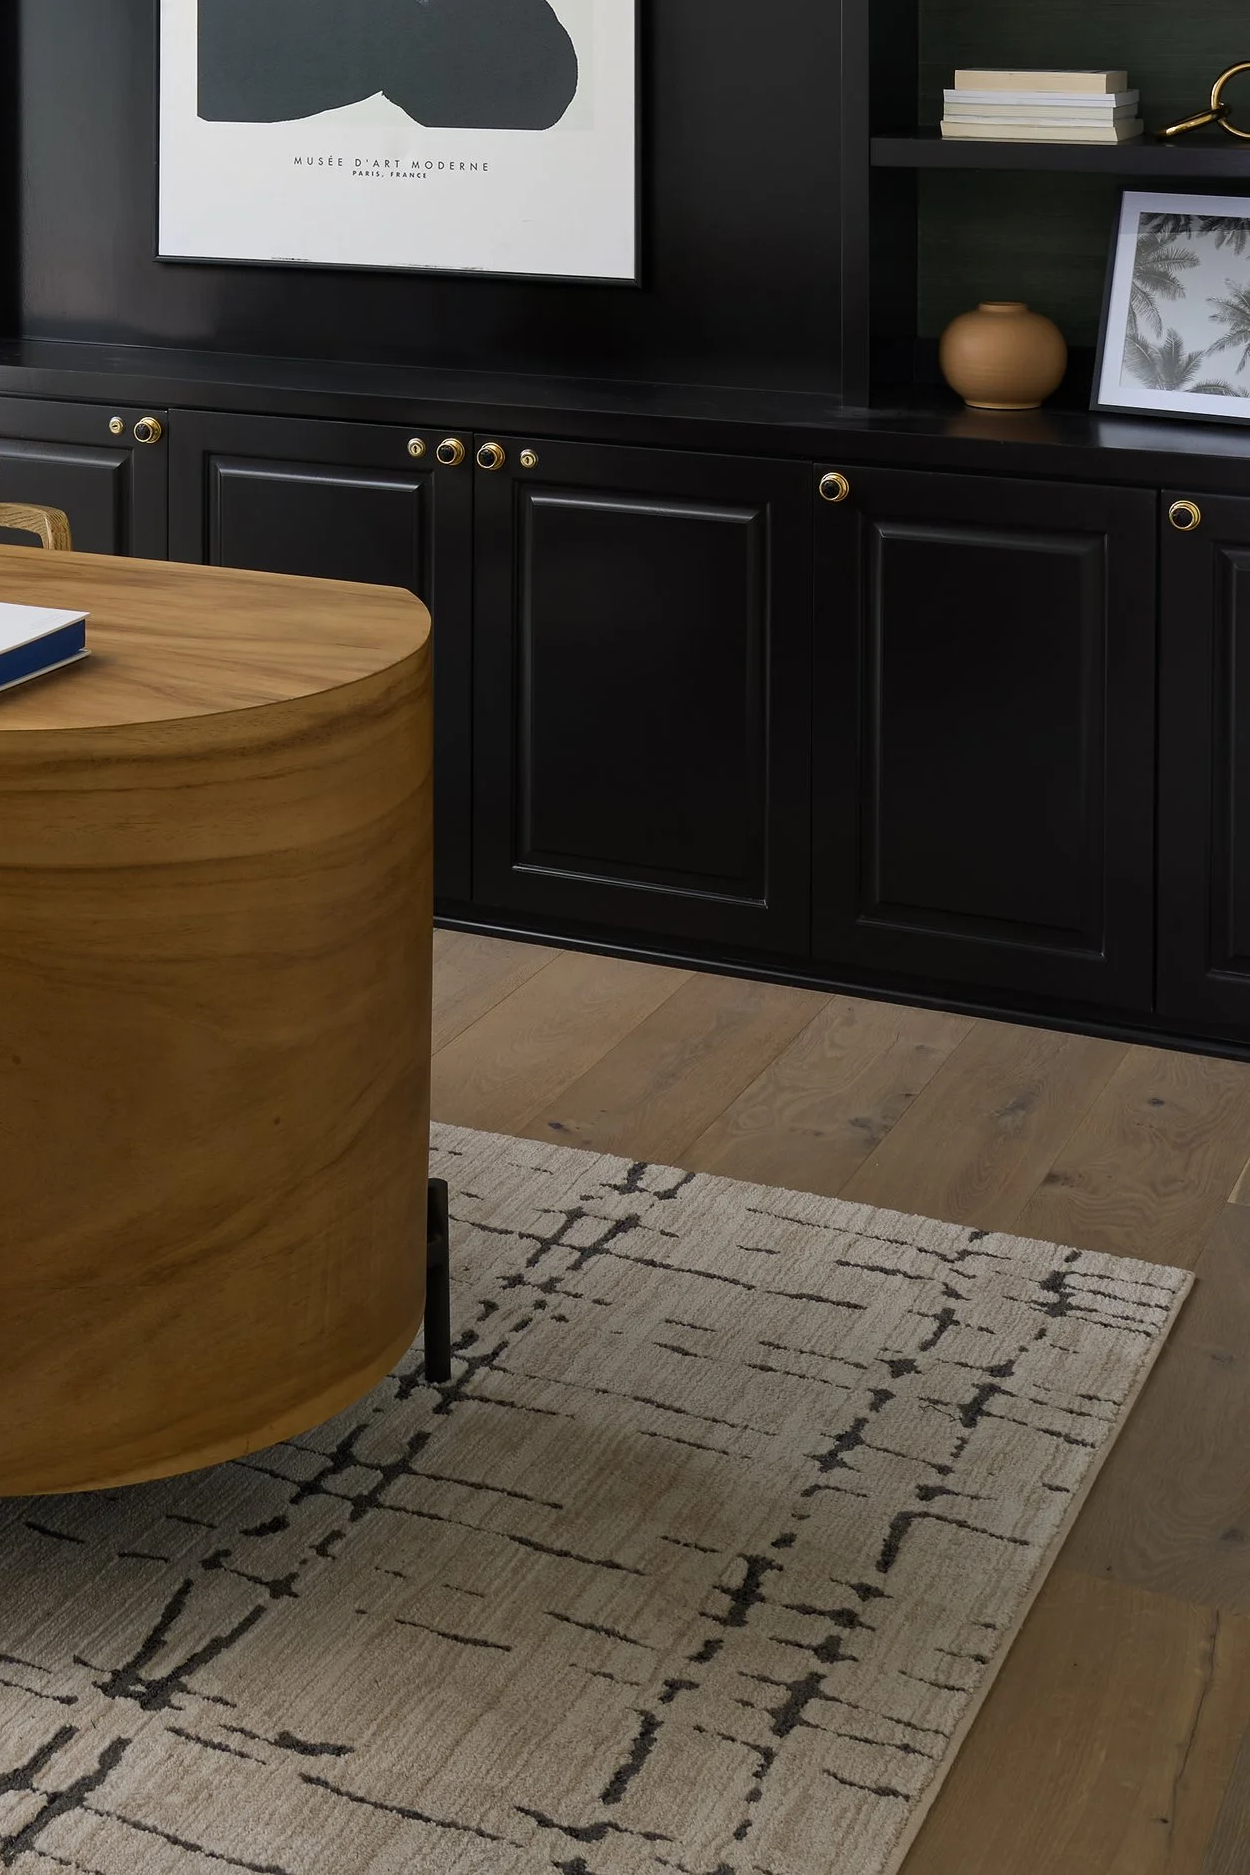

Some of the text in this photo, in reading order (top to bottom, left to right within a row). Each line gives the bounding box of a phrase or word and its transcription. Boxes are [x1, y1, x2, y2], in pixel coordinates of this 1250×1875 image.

[293, 155, 489, 172] MUSÉE D'ART MODERNE
[352, 170, 427, 179] PARIS, FRANCE
